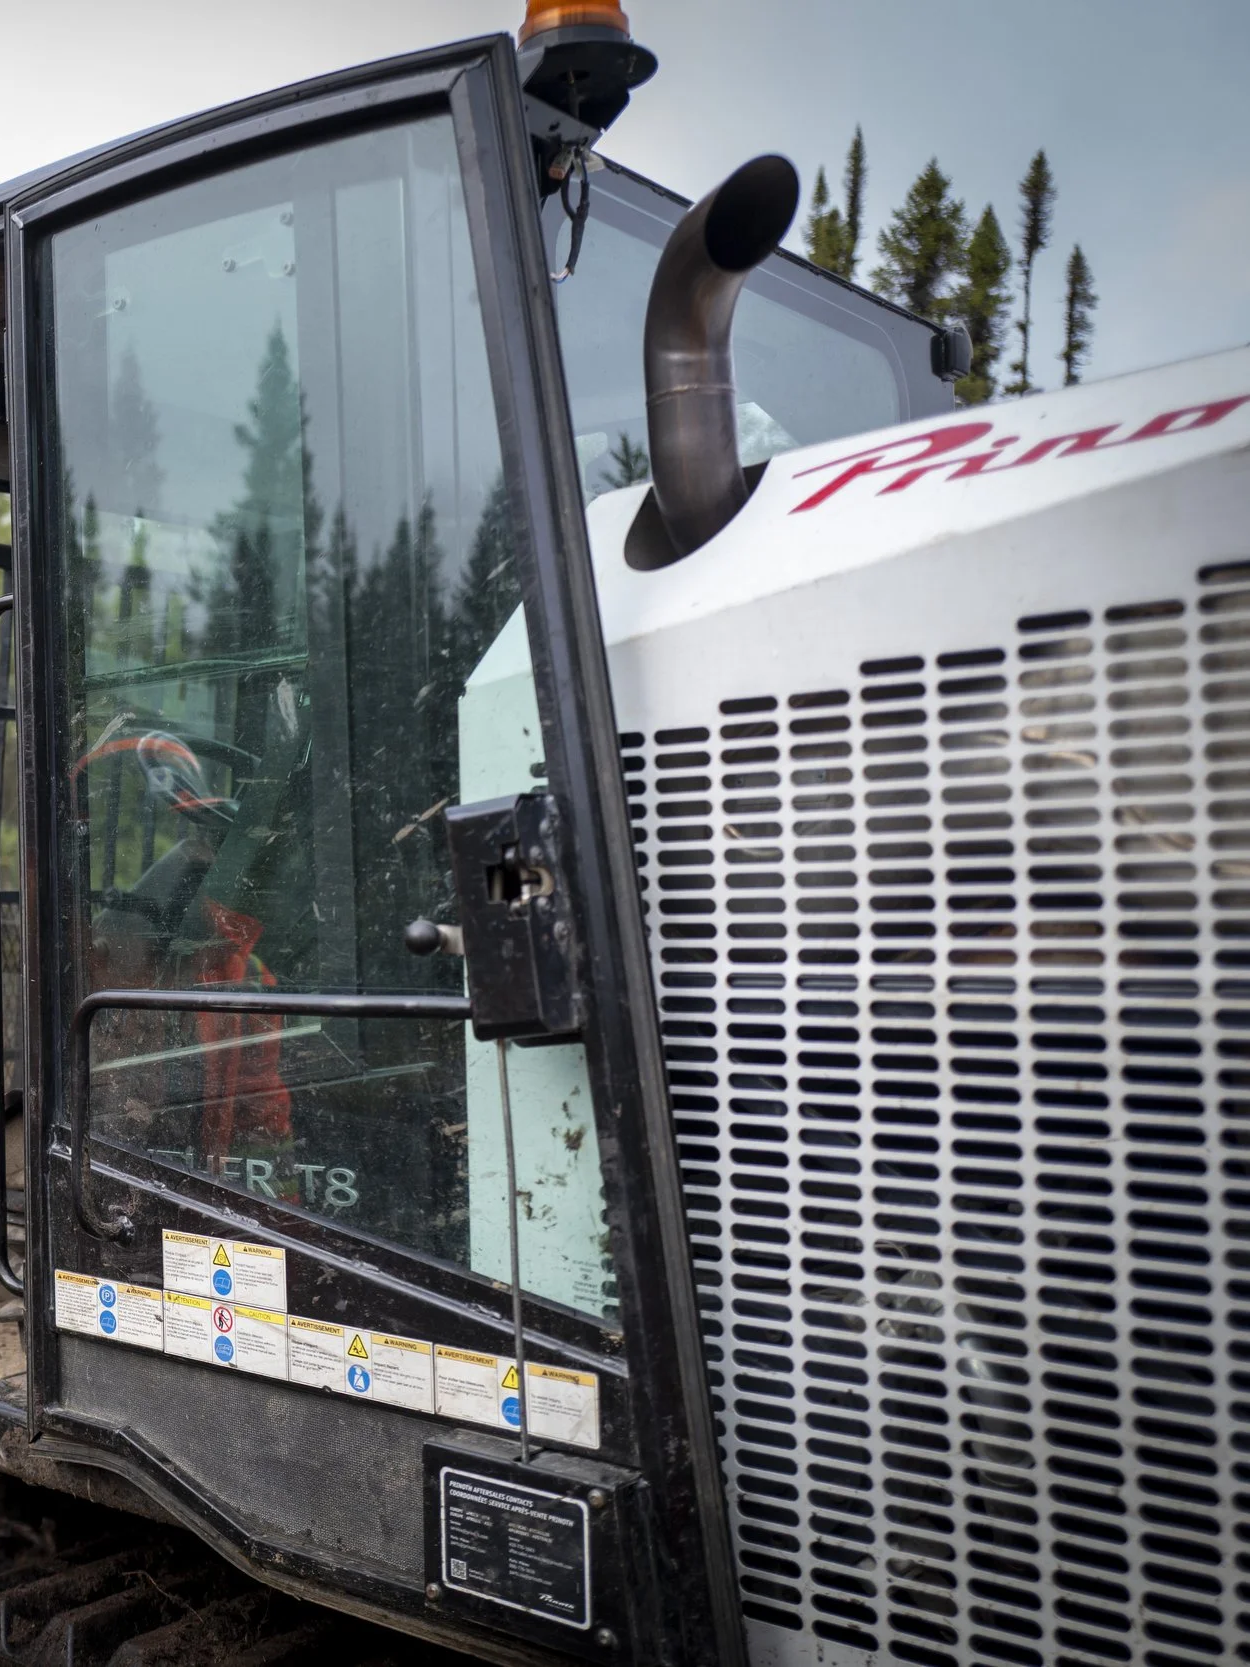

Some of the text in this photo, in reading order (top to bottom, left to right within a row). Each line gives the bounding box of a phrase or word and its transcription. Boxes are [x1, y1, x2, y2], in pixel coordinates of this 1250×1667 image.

[294, 1163, 360, 1208] T8
[170, 1234, 208, 1245] AVERTISSEMENT
[248, 1247, 272, 1256] WARNING
[248, 1310, 271, 1321] CAUTION
[297, 1320, 341, 1334] AVERTISSEMENT
[389, 1339, 417, 1350] WARNING
[444, 1350, 494, 1365] AVERTISSEMENT
[548, 1370, 580, 1382] WARNING
[473, 1486, 506, 1501] AFTERSALES
[506, 1495, 534, 1508] CONTACTS
[488, 1500, 510, 1511] SERVICE
[510, 1505, 548, 1520] APRÈS-VENTE
[548, 1514, 575, 1527] PRINOTH
